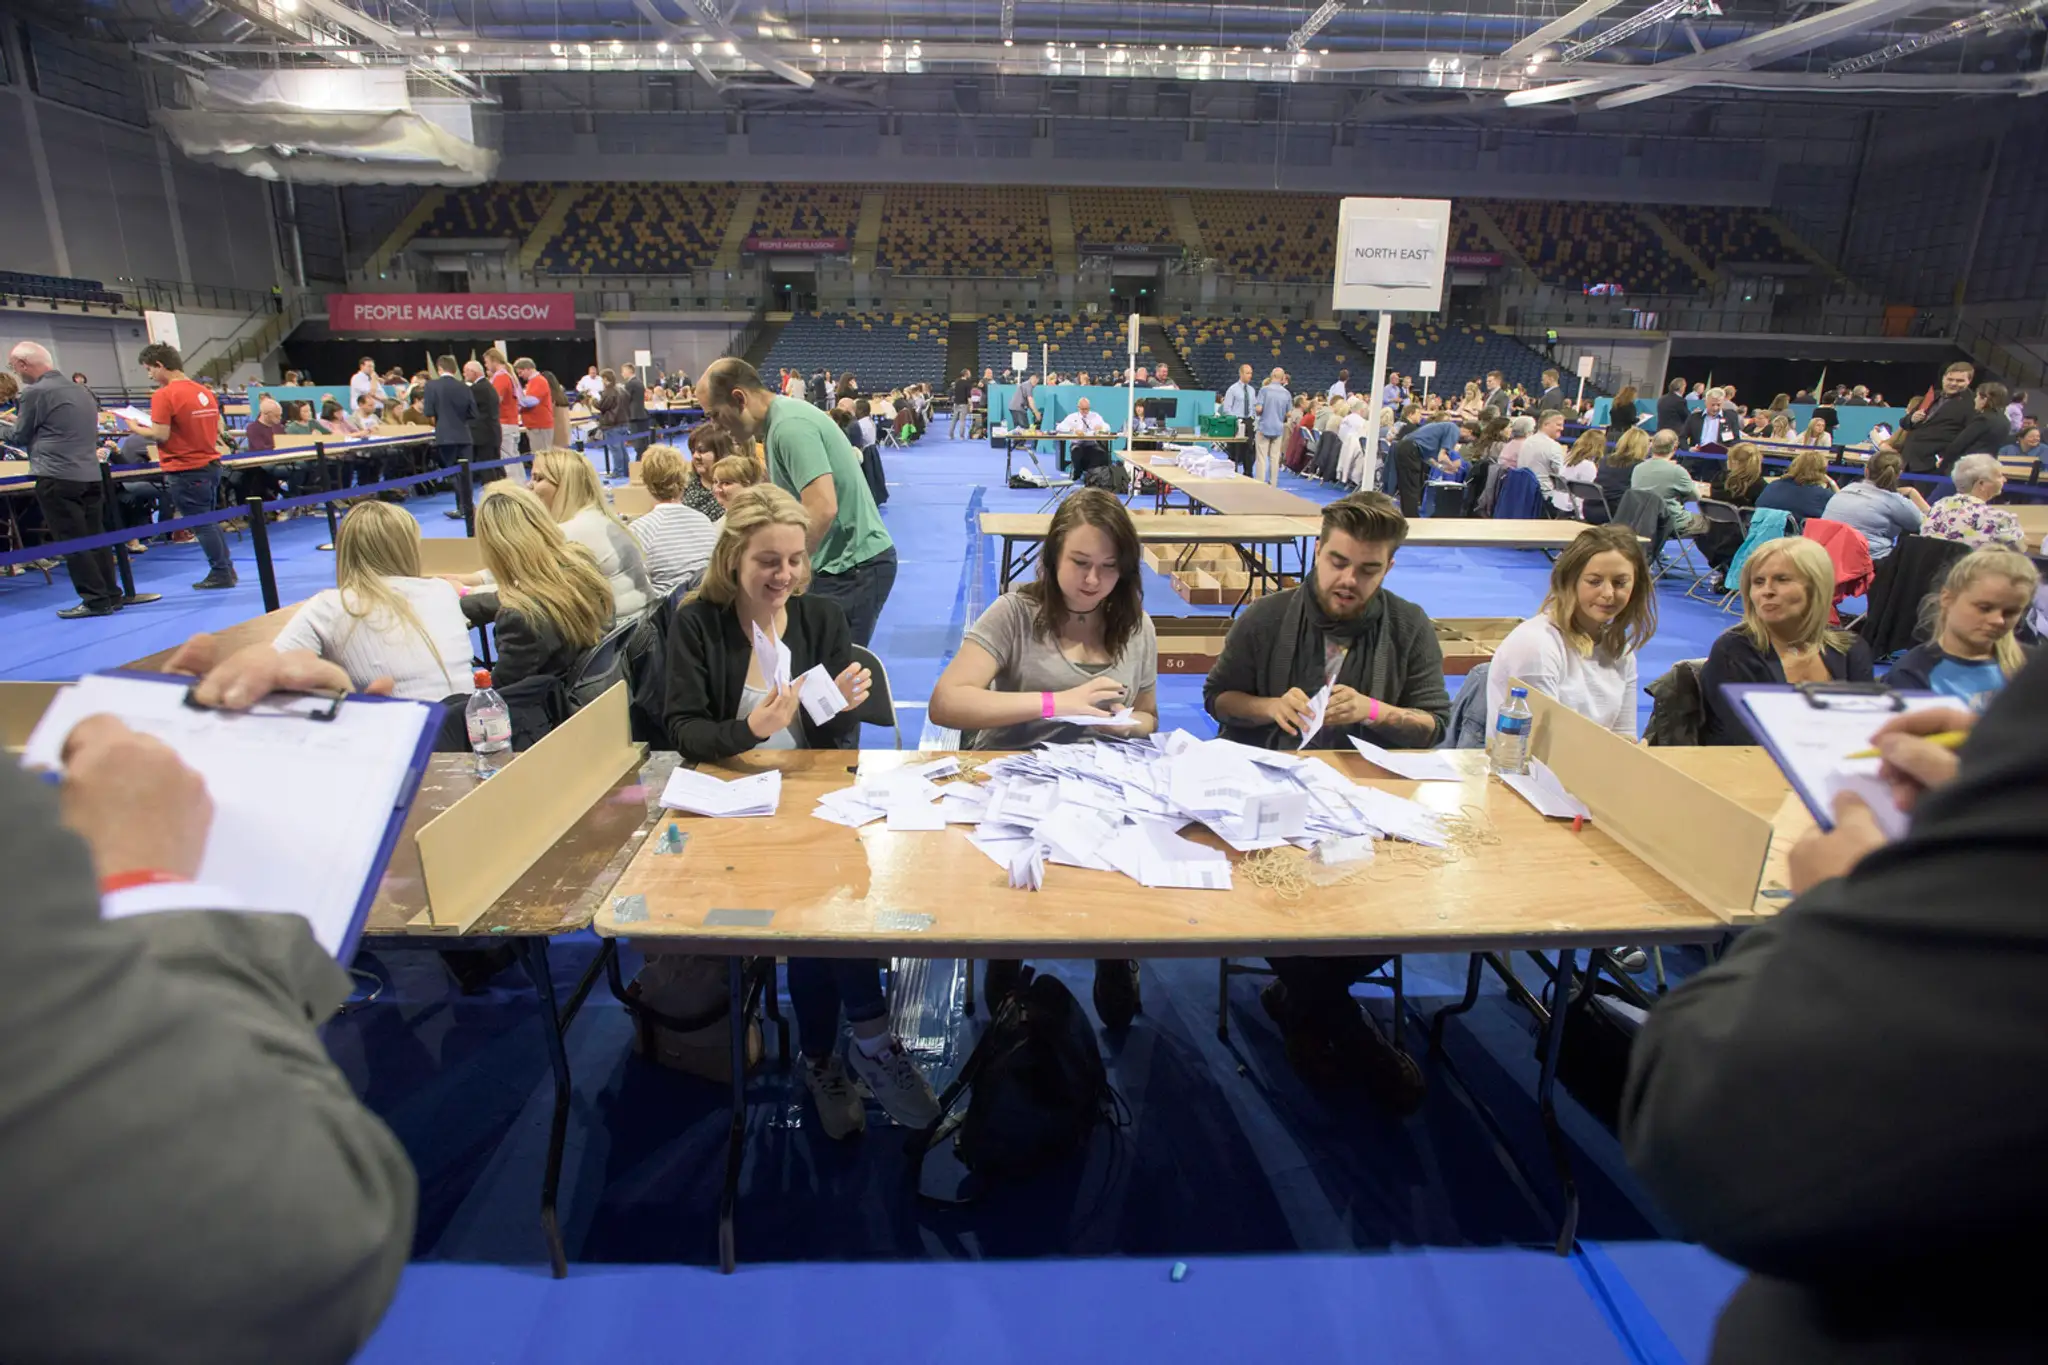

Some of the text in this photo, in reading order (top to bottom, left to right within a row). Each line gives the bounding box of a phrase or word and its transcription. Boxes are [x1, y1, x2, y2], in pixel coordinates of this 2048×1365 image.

[758, 241, 782, 249] PEOPLE
[1355, 247, 1430, 260] NORTH EAST
[354, 304, 549, 320] PEOPLE MAKE GLASGOW
[1166, 658, 1185, 668] 50
